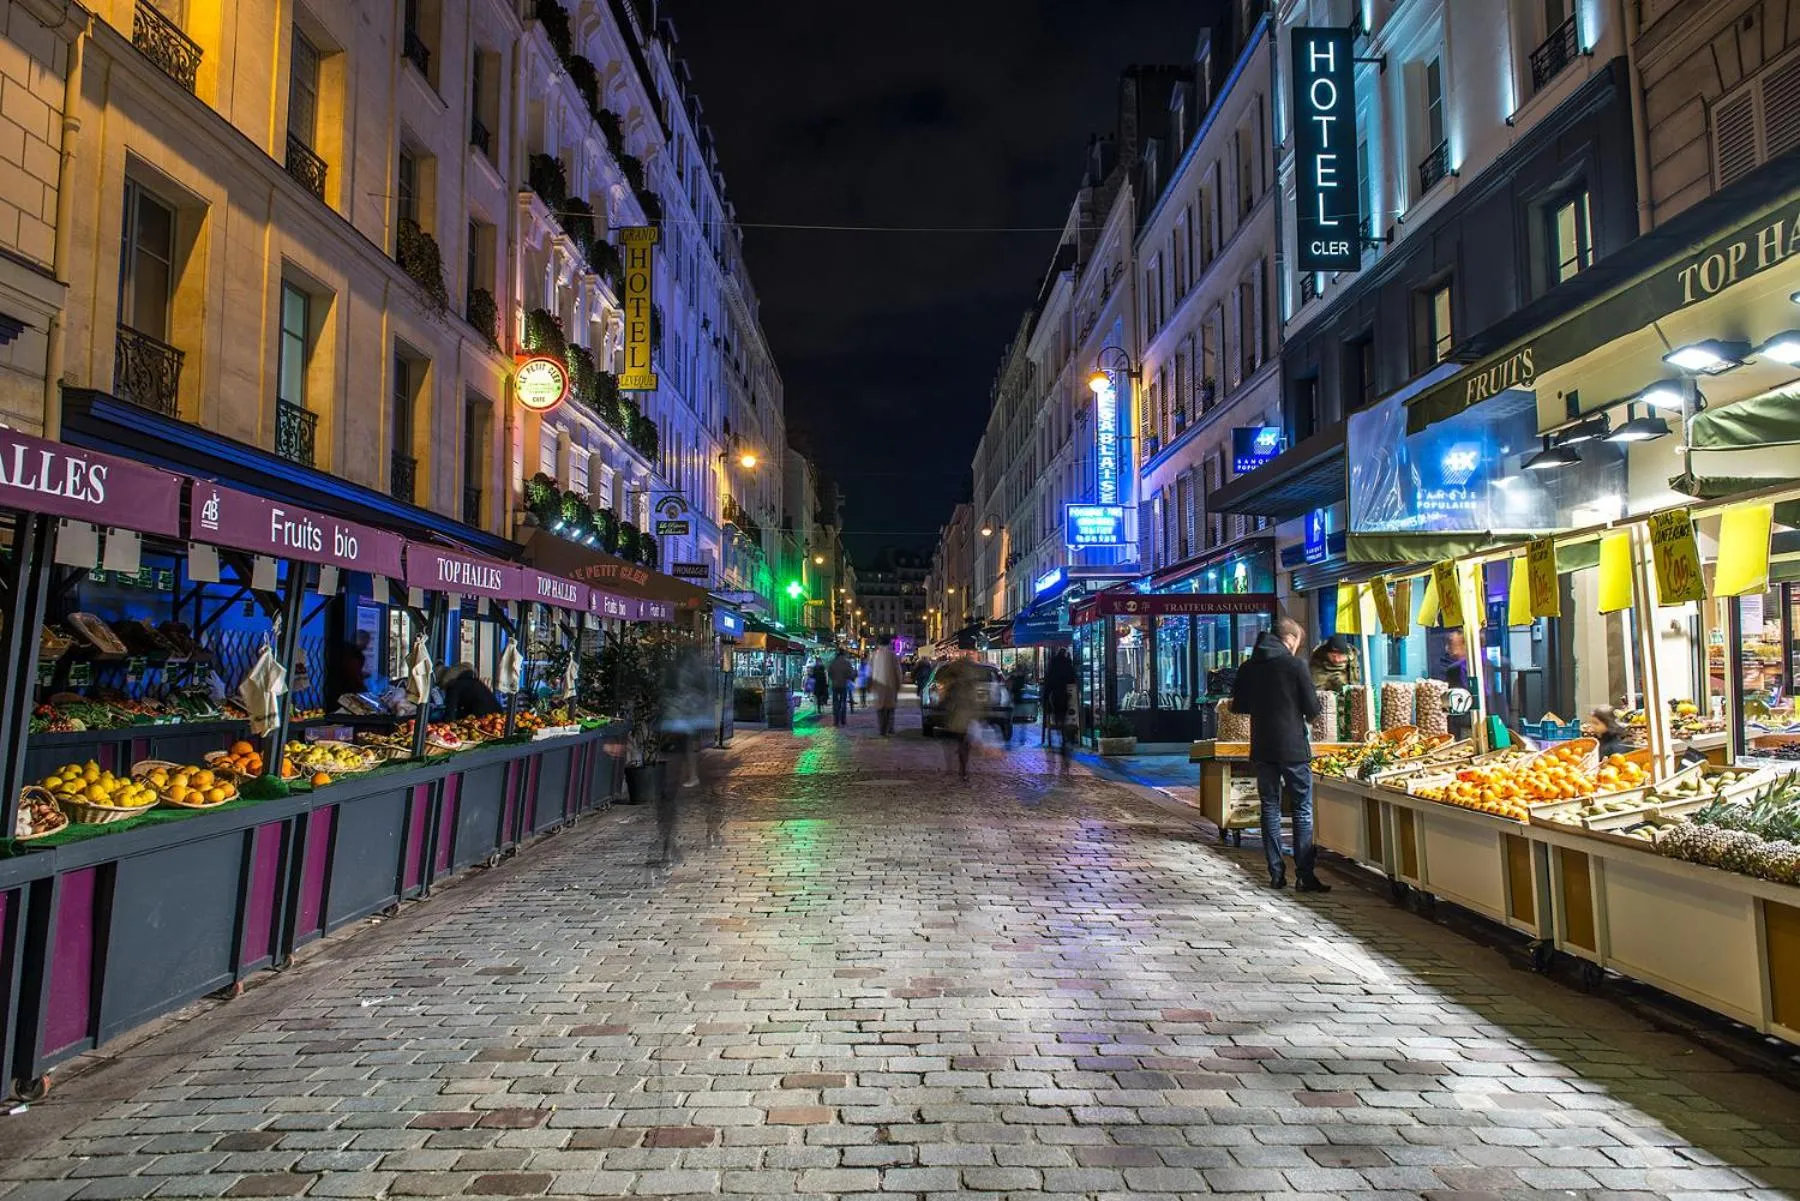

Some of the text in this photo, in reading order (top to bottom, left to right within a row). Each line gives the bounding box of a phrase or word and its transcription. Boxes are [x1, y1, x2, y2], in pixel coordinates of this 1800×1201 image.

[1309, 41, 1339, 225] HOTEL
[622, 228, 656, 241] GRAND
[1311, 241, 1349, 255] CLER
[1678, 241, 1746, 305] TOP
[629, 247, 647, 368] HOTEL
[519, 363, 561, 384] LE PETIT CLER
[1465, 347, 1534, 406] FRUITS
[1416, 490, 1477, 501] BANQUE
[1416, 501, 1477, 510] POPULAIRE
[202, 499, 219, 521] AB
[271, 508, 358, 560] Fruits bio
[437, 557, 501, 591] TOP HALLES
[586, 564, 619, 578] PETIT
[537, 576, 577, 602] TOP HALLES
[1164, 603, 1268, 612] TRAITEUR ASIATIQUE
